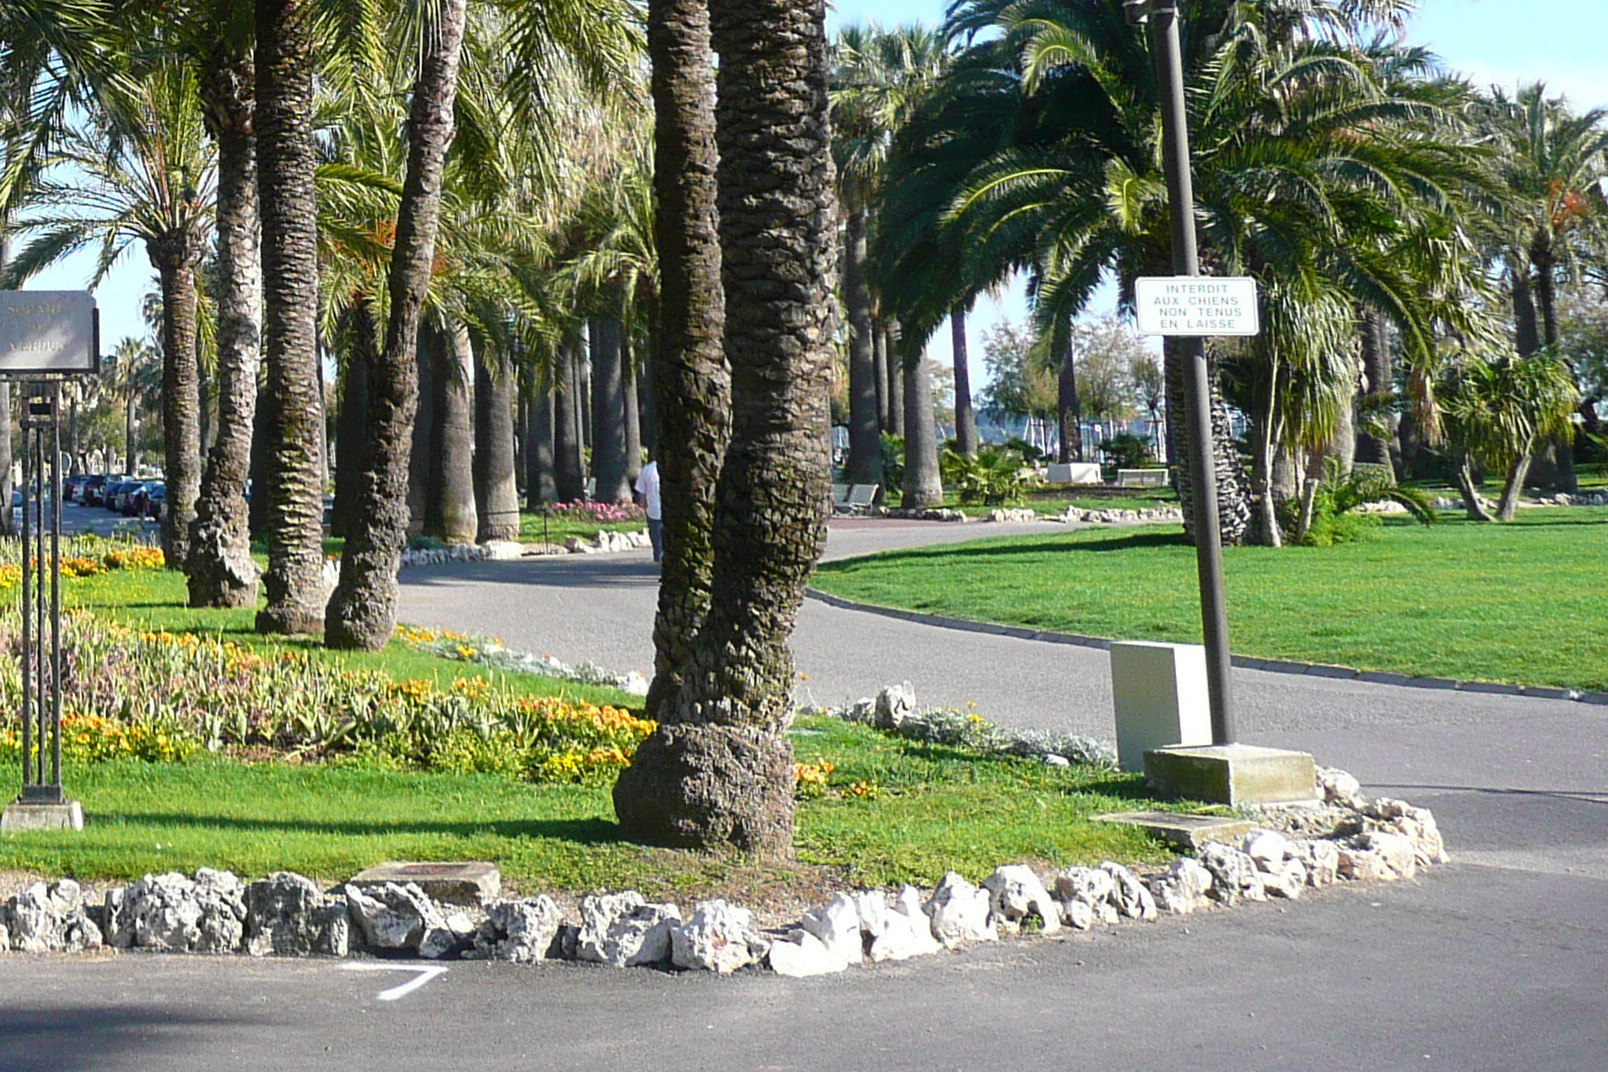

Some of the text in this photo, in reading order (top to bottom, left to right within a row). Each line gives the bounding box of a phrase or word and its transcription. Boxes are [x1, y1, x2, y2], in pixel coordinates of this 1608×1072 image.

[1166, 284, 1228, 294] INTERDIT
[1154, 296, 1239, 305] AUX CHIENS
[1159, 308, 1242, 317] NON TENUS
[1160, 319, 1236, 329] EN LAISSE
